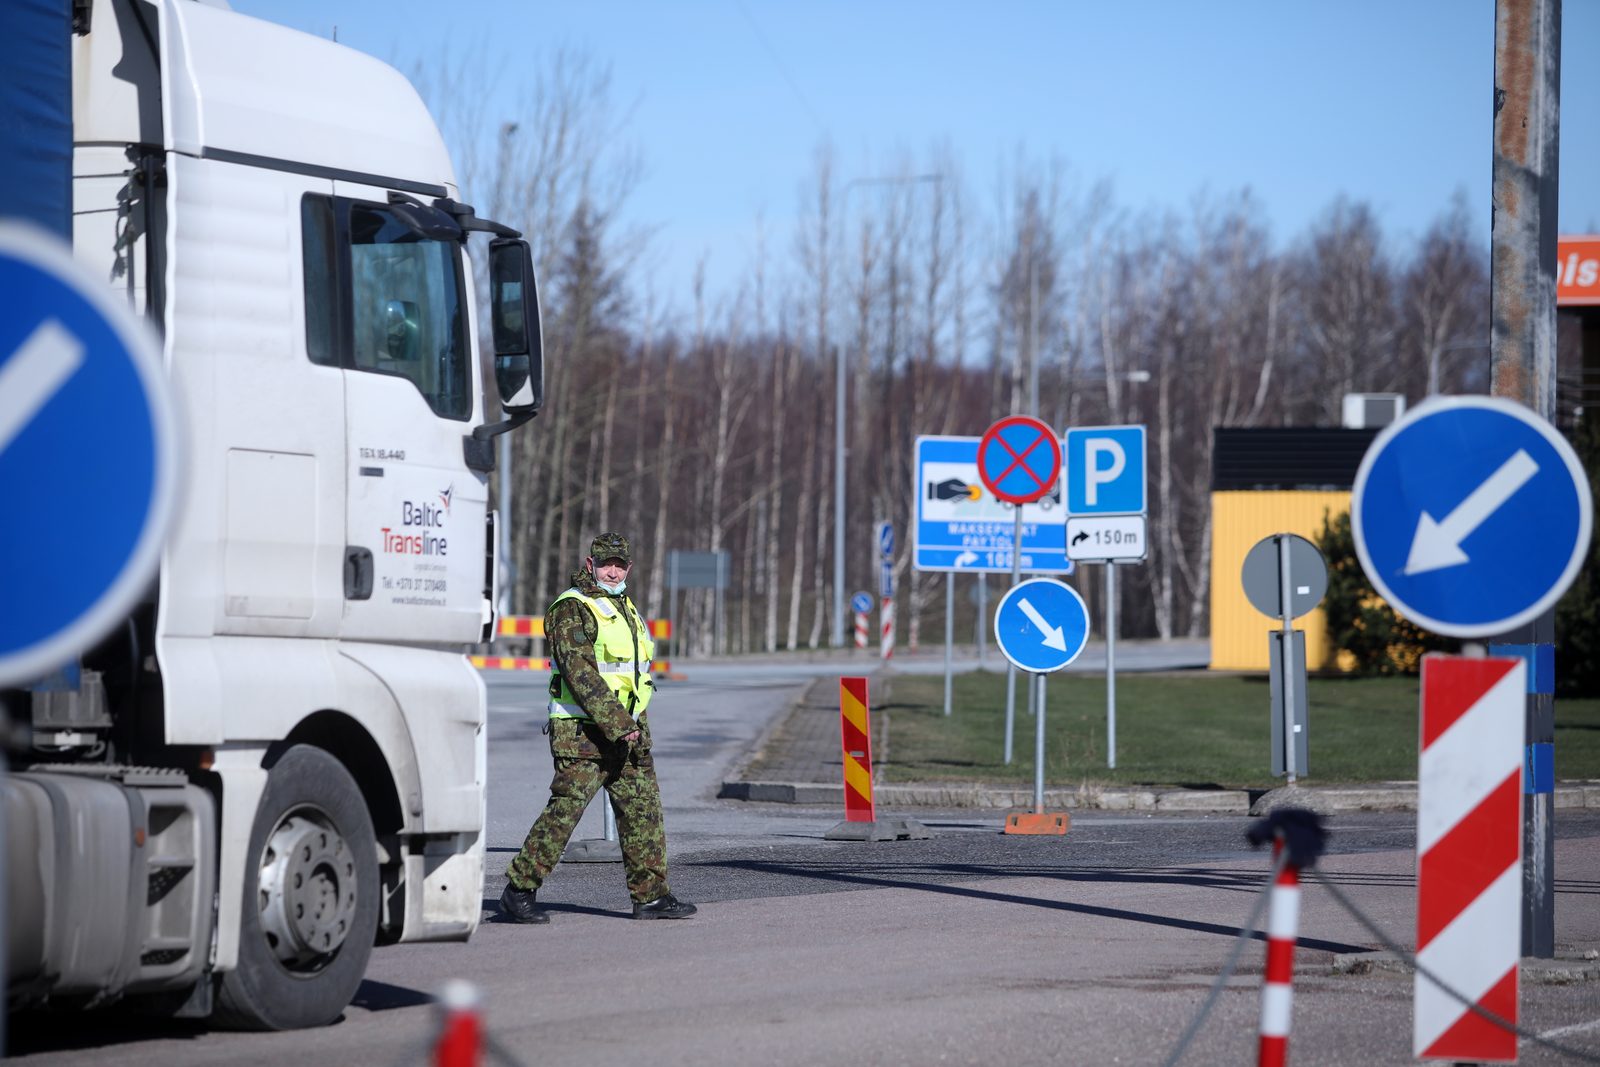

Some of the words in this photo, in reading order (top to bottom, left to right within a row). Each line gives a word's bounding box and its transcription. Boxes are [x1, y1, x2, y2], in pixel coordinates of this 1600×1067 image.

[1085, 437, 1126, 506] P
[402, 501, 443, 528] Baltic
[381, 528, 447, 556] Transline
[382, 576, 394, 590] Tel.
[396, 577, 412, 591] +370
[414, 578, 422, 591] 37
